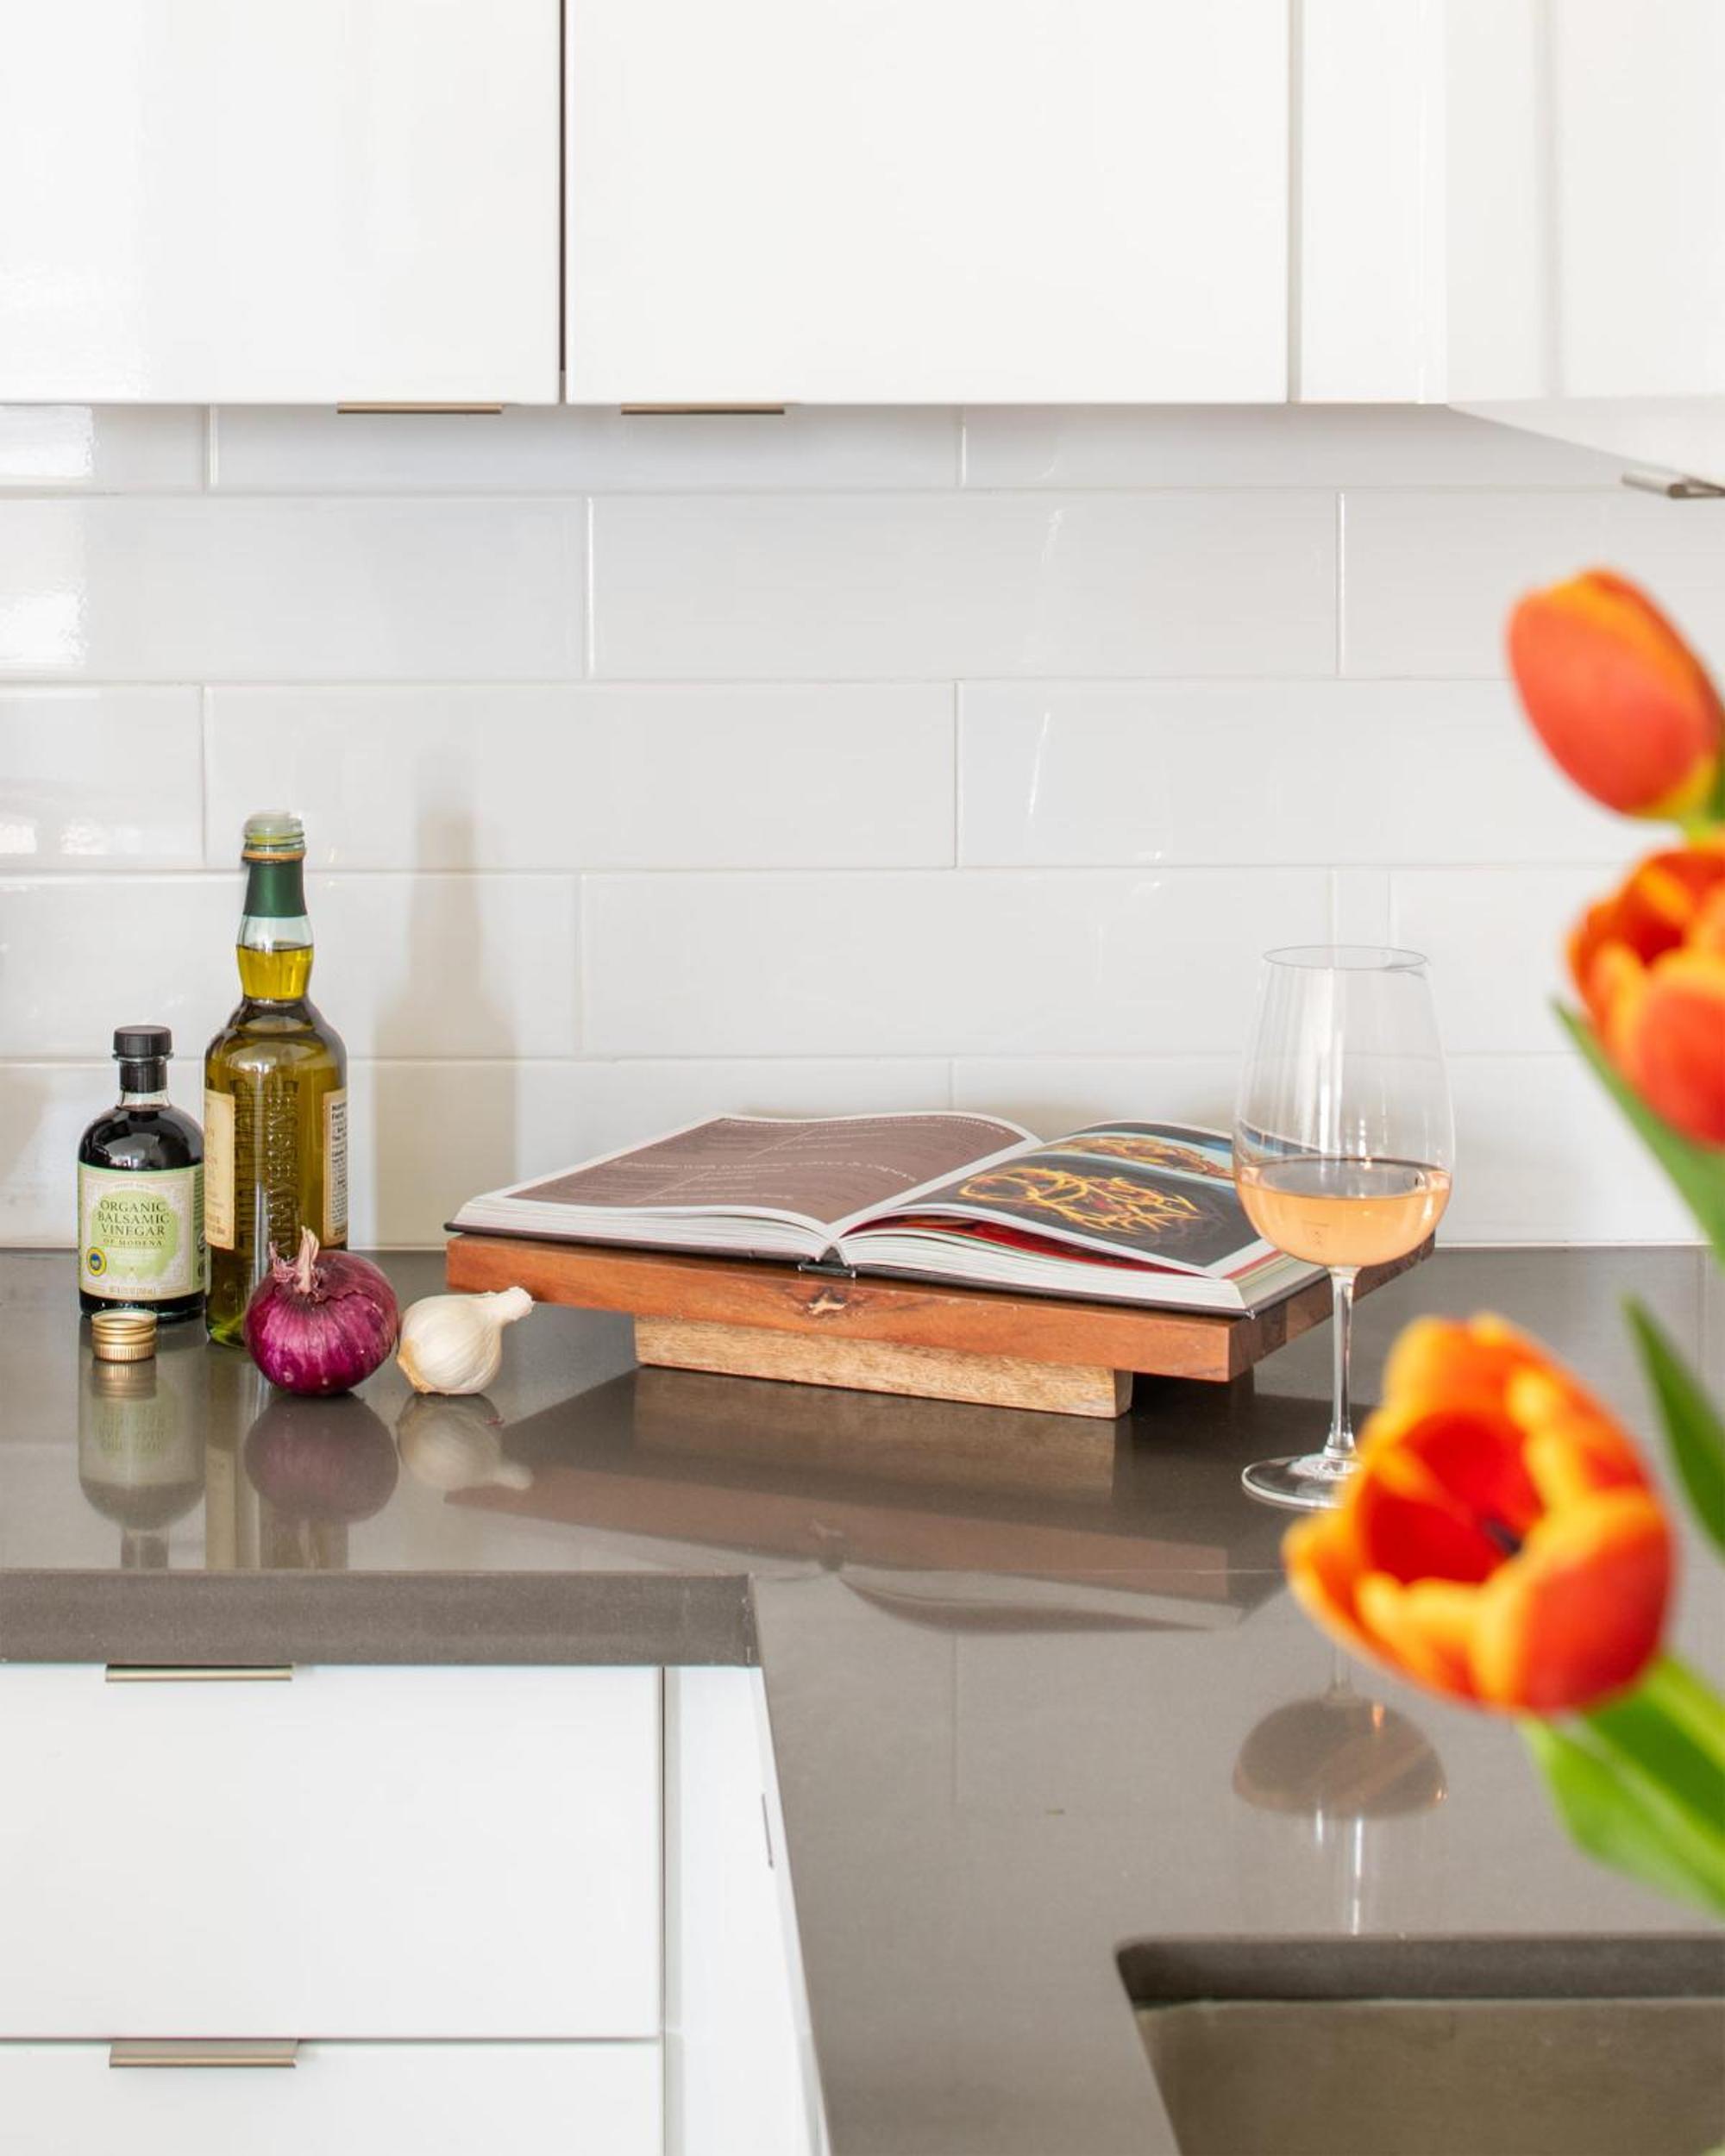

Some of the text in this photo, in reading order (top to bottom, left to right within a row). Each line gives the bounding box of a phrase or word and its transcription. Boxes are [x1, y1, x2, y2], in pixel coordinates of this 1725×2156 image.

[100, 1200, 166, 1213] ORGANIC
[98, 1211, 169, 1224] BALSAMIC
[101, 1223, 165, 1236] VINEGAR
